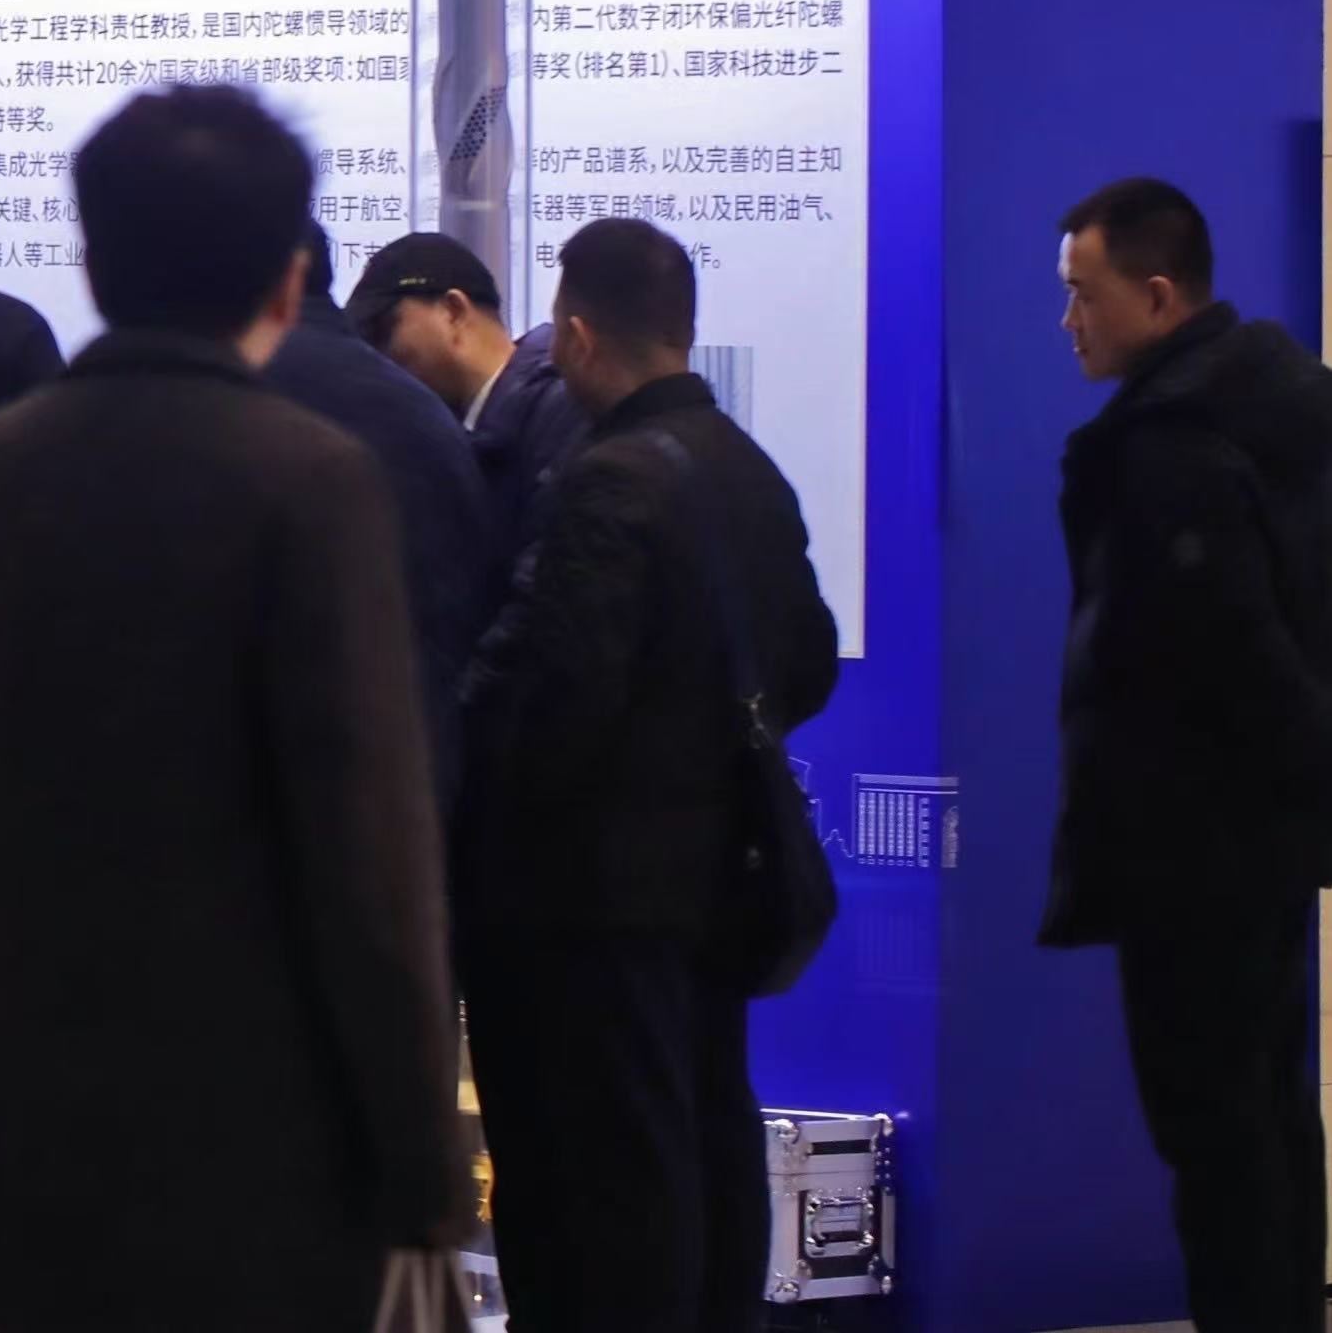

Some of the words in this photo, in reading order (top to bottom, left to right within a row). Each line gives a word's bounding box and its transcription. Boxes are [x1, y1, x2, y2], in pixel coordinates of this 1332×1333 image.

[532, 145, 843, 176] 的产品谱系，以及完善的自主知
